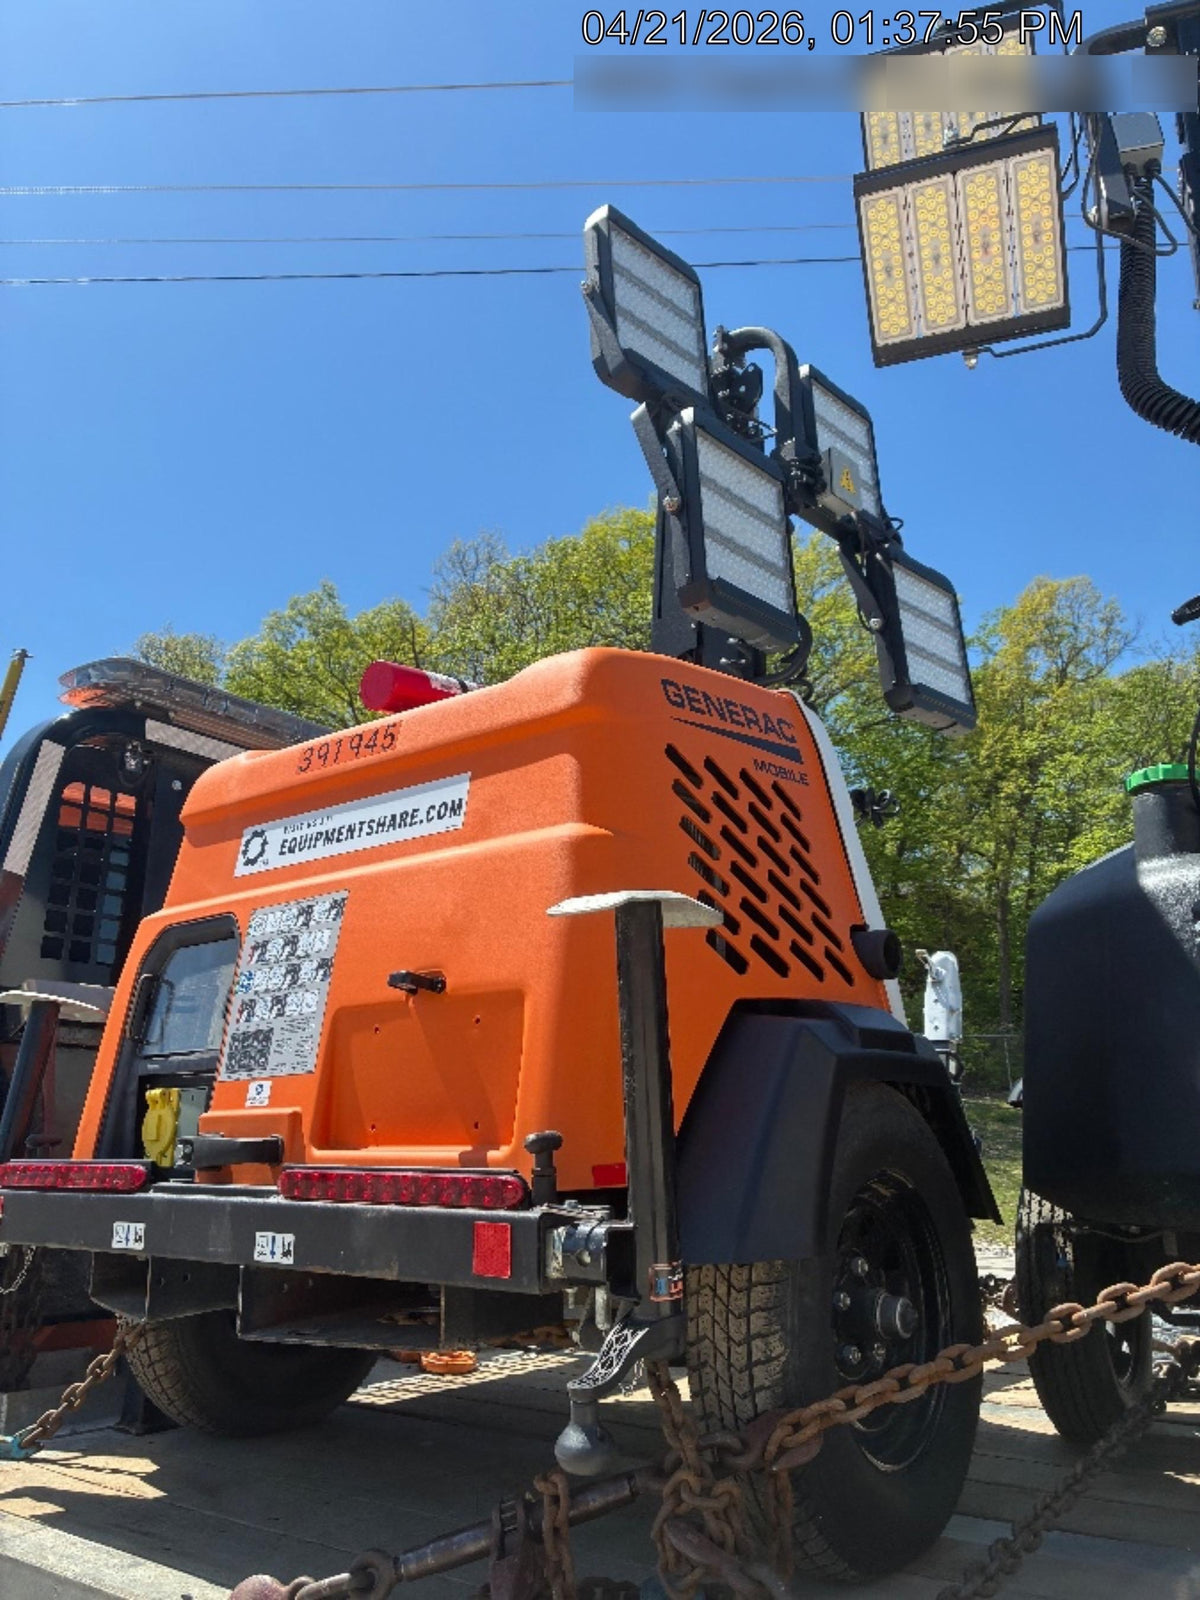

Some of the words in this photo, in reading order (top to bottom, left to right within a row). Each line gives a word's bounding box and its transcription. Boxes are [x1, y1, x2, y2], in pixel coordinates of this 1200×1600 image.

[660, 678, 797, 744] GENERAC
[298, 723, 398, 773] 391945
[753, 758, 810, 786] MOBILE
[278, 797, 464, 856] EQUIPMENTSHARE.COM
